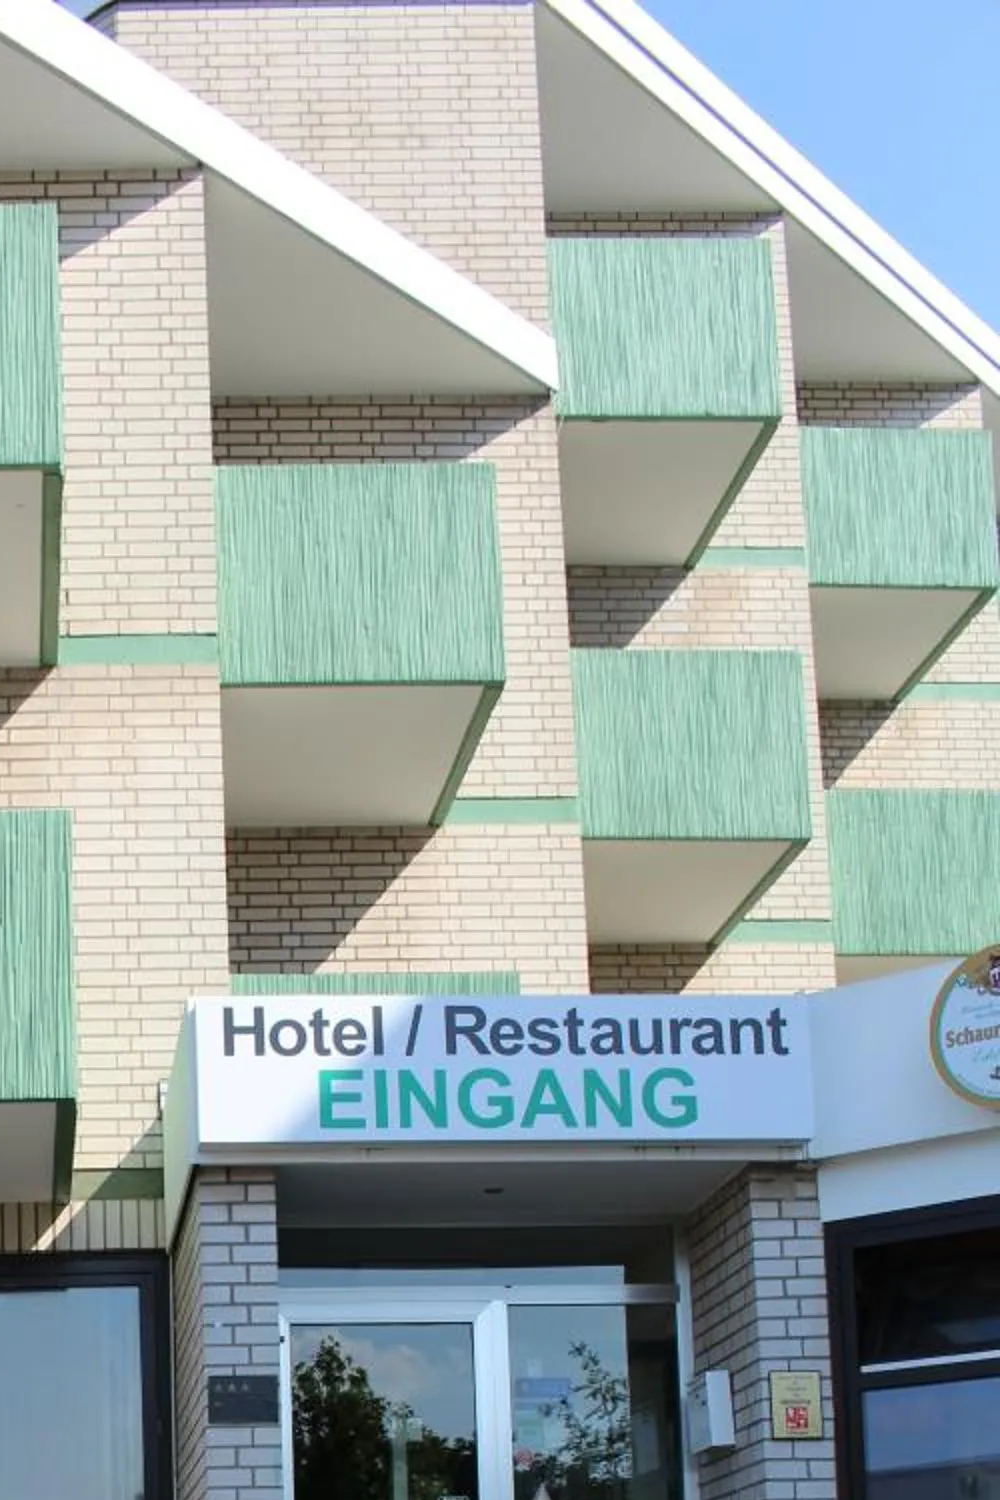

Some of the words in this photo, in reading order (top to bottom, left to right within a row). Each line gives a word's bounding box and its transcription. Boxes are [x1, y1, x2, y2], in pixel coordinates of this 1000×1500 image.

[222, 1006, 385, 1057] Hotel
[445, 1005, 789, 1056] Restaurant
[318, 1068, 698, 1129] EINGANG
